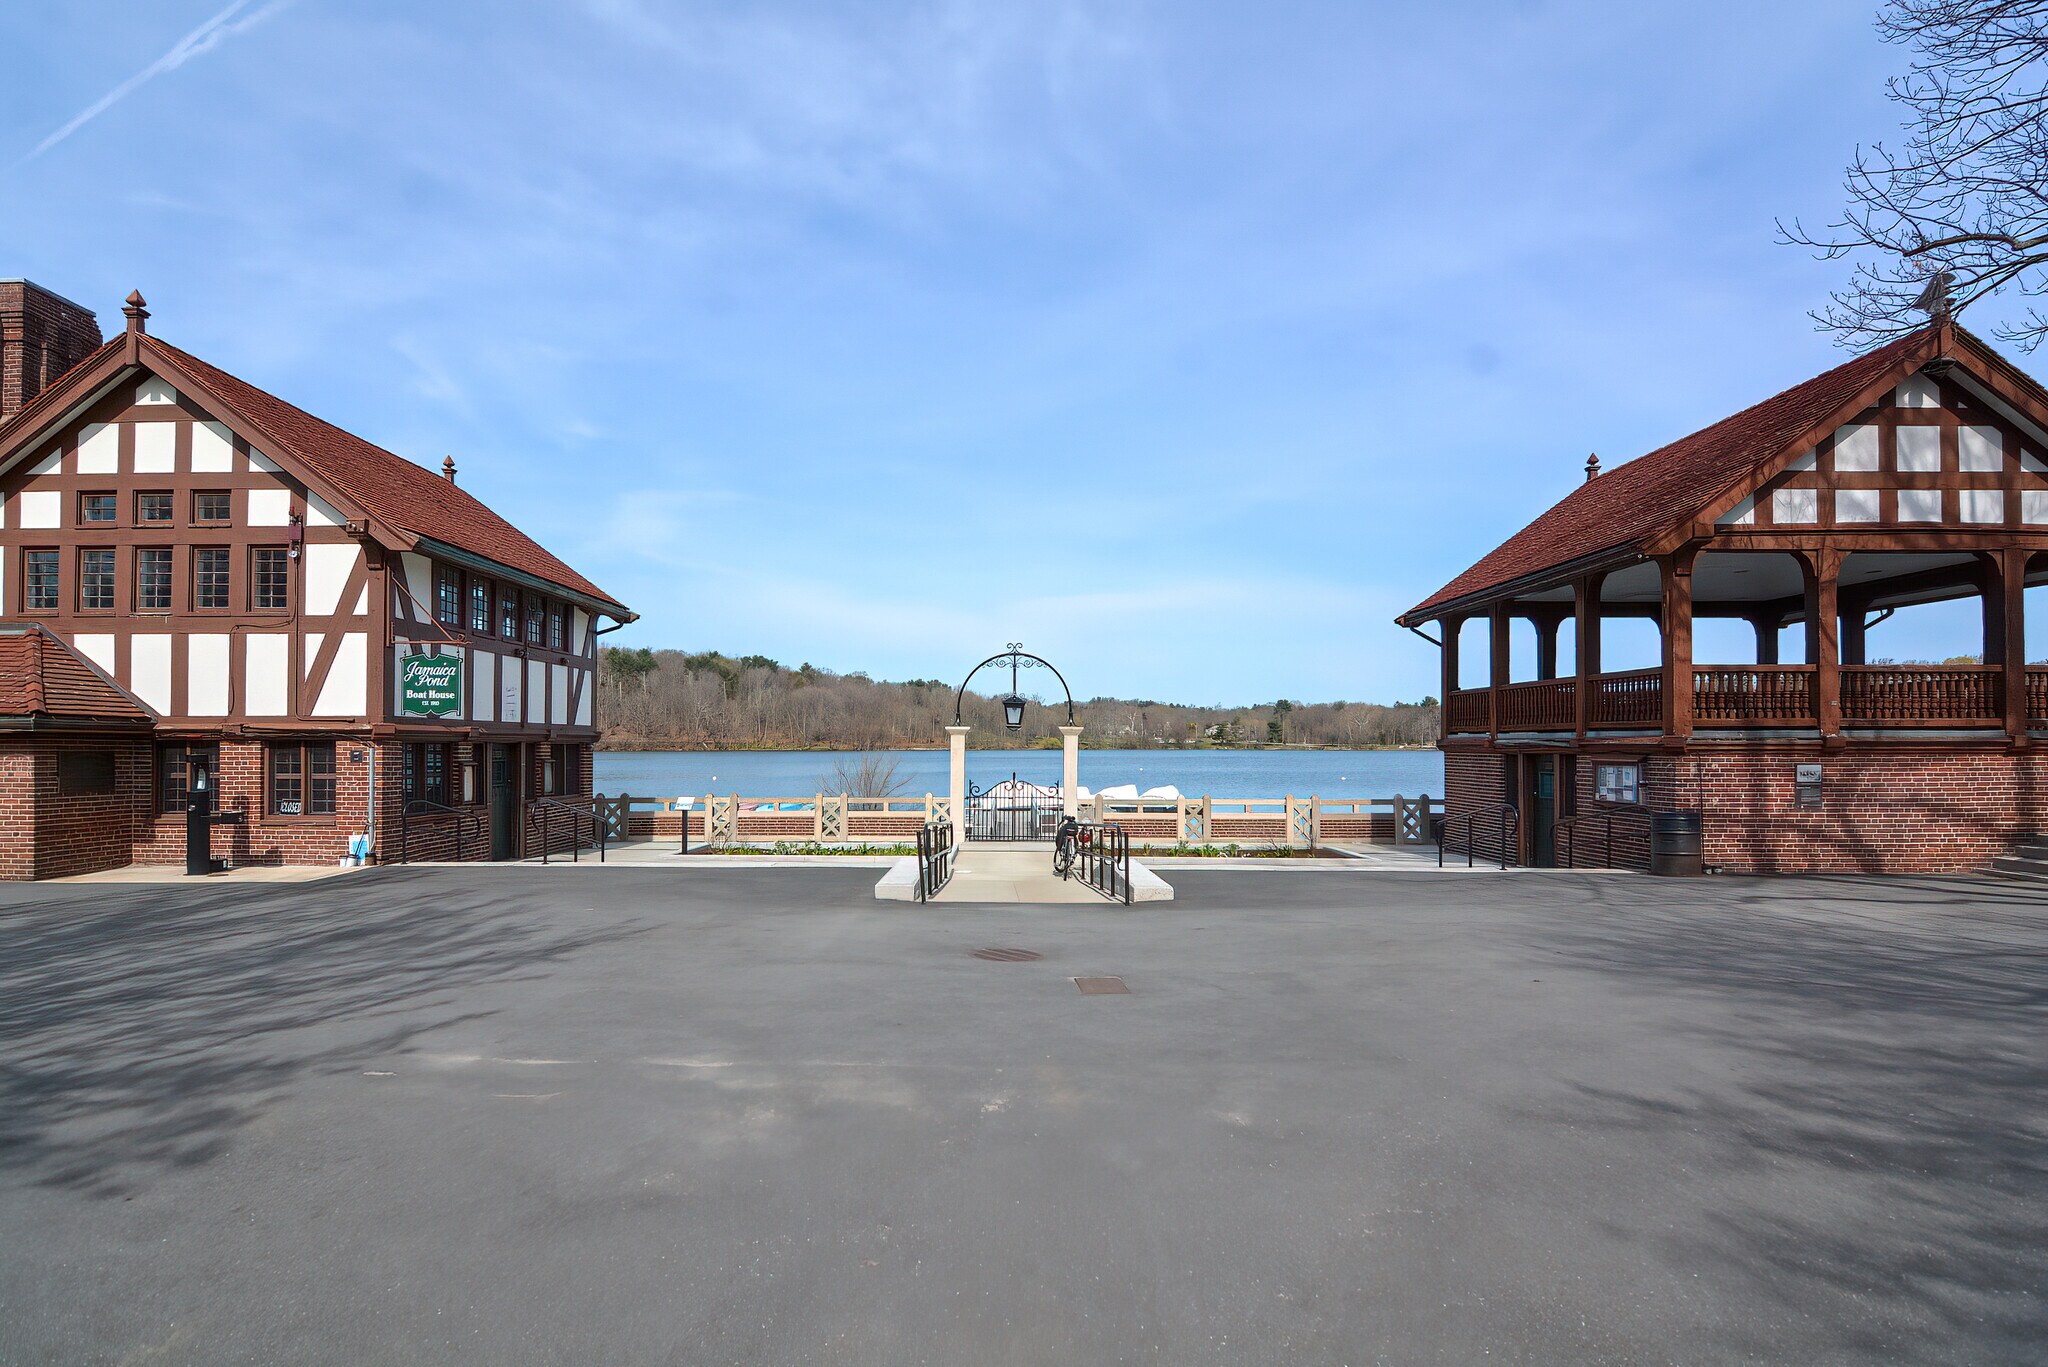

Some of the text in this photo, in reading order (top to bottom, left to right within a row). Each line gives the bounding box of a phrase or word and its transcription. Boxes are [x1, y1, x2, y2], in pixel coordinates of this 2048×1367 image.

[404, 661, 456, 682] Jamaica
[415, 674, 449, 687] Pond
[406, 690, 455, 699] Boat House
[280, 801, 302, 813] CLOSED
